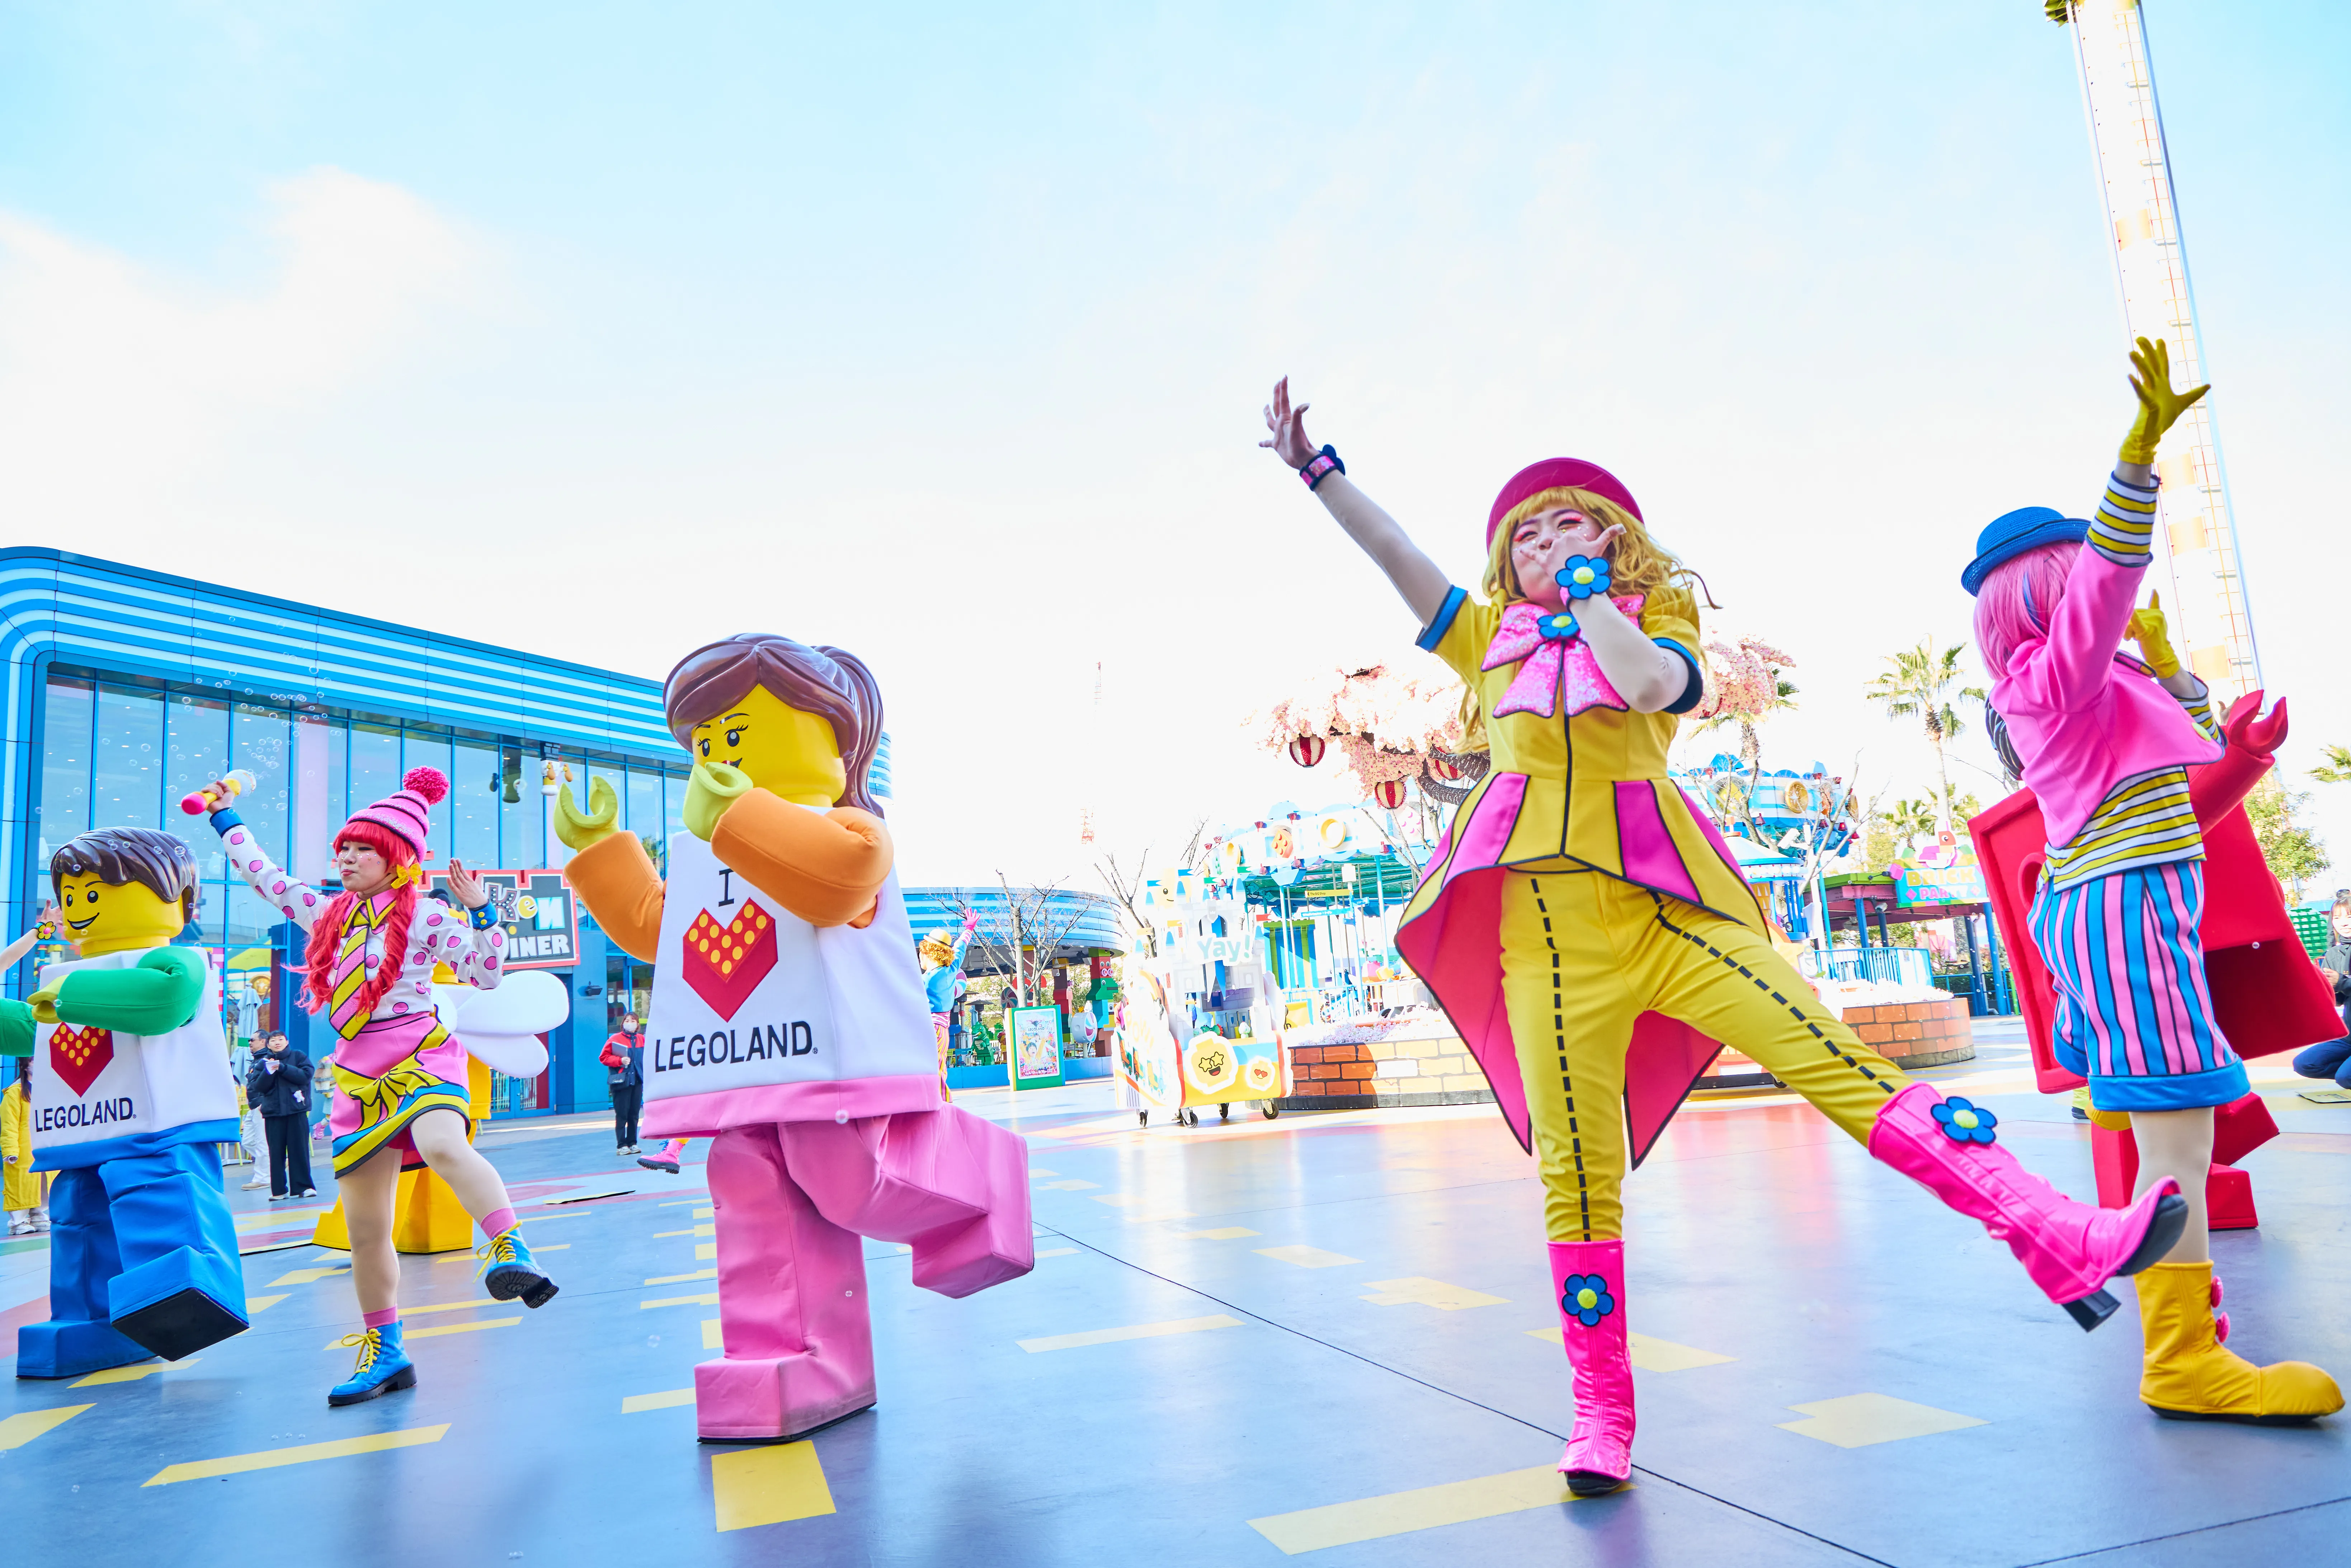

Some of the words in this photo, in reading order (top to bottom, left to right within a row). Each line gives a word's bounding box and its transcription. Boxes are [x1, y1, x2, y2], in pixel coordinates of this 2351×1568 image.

[719, 868, 734, 907] I
[1906, 866, 1977, 887] BRICK
[1919, 885, 1968, 900] PARTY
[1196, 934, 1250, 962] Yay!
